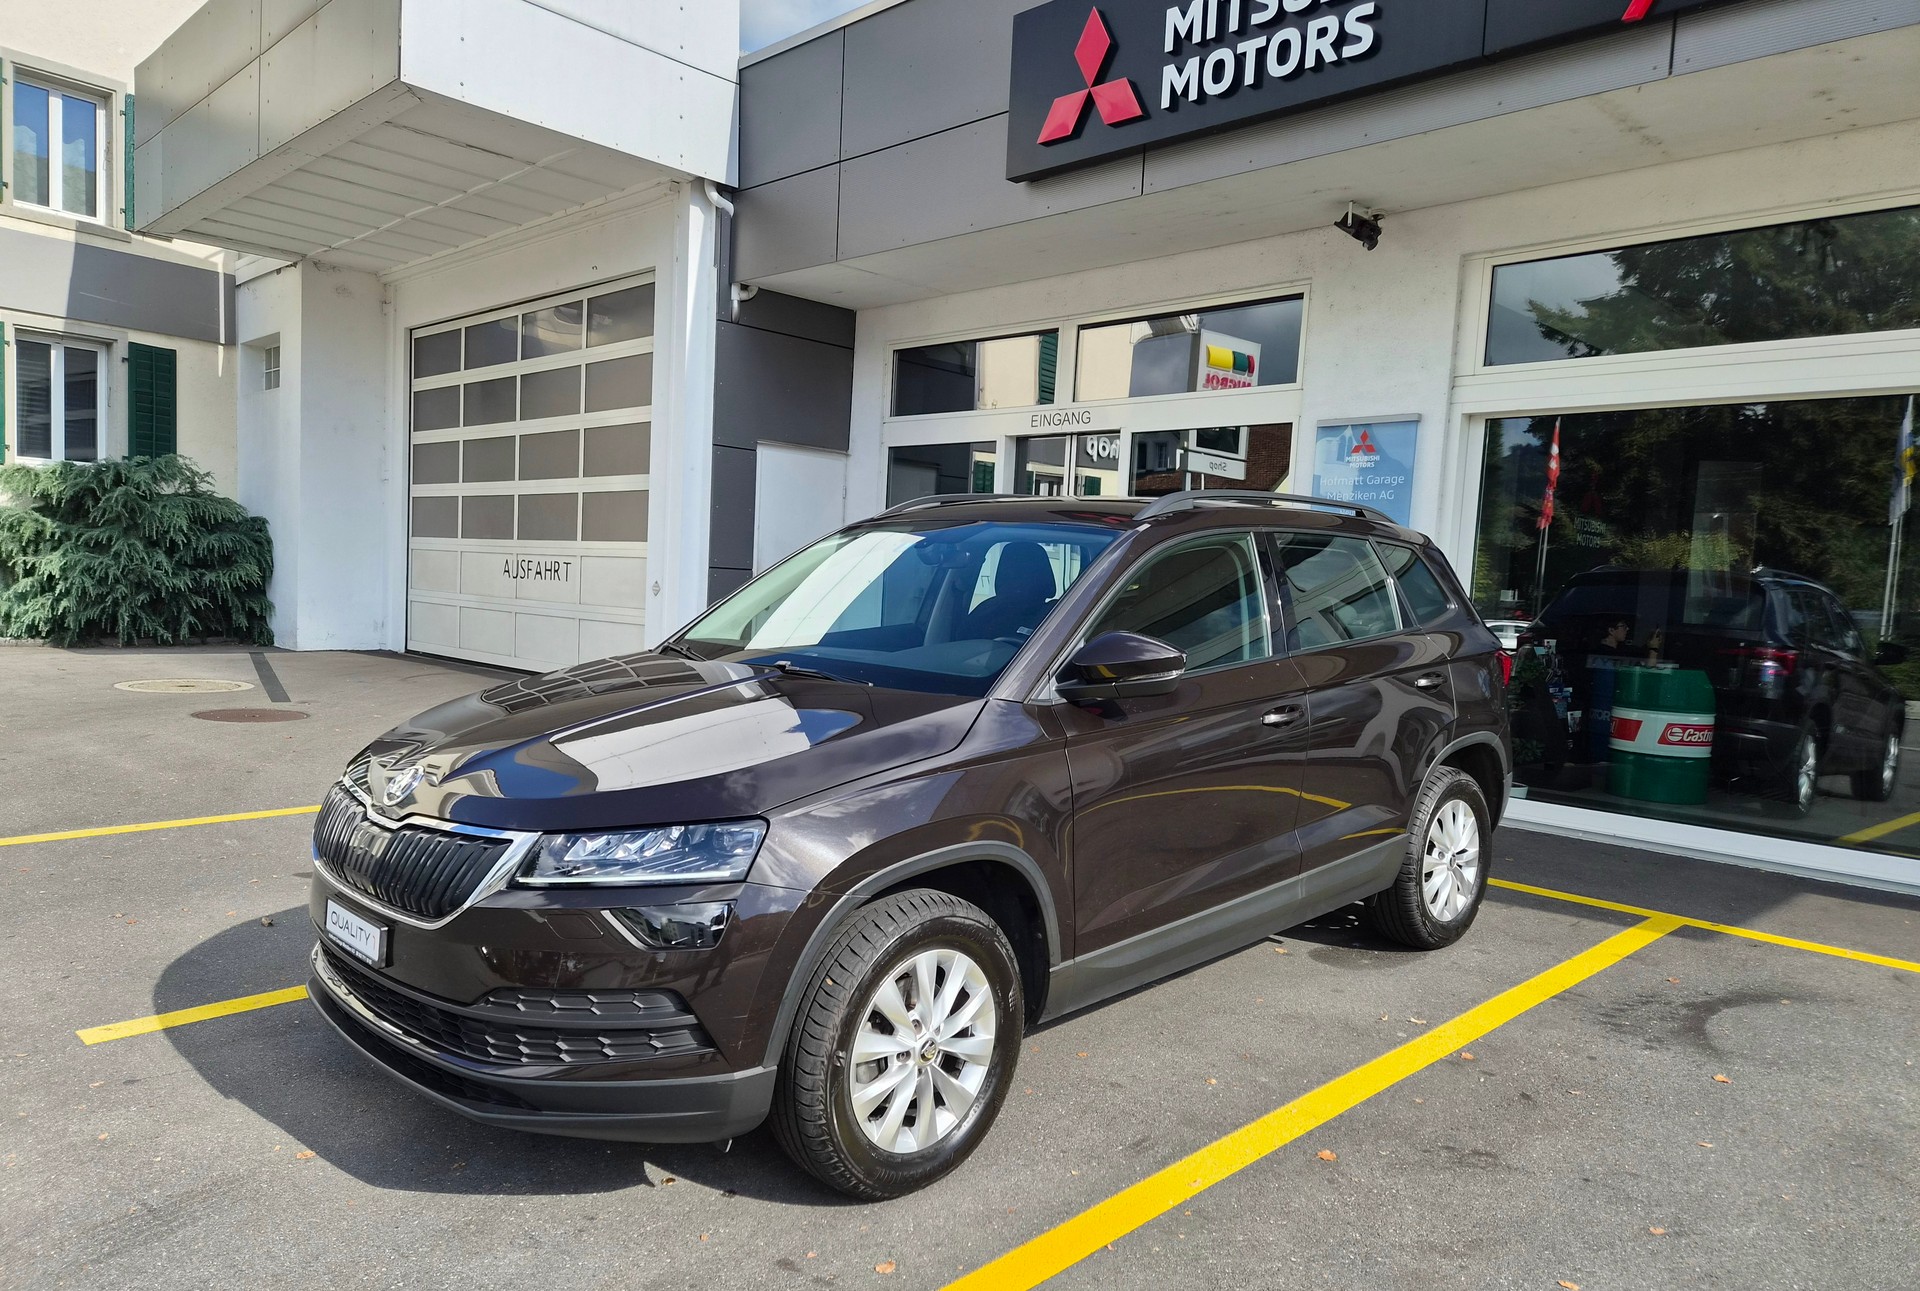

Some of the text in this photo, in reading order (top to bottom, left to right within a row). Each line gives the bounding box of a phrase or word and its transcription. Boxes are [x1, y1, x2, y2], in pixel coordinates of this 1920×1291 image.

[1164, 0, 1329, 53] MITS
[1160, 2, 1375, 110] MOTORS
[1031, 410, 1091, 428] EINGANG
[1345, 455, 1380, 463] MITSUBISHI
[1320, 474, 1405, 487] Hofmatt Garage
[1327, 489, 1395, 501] Menziken AG
[1573, 516, 1607, 534] MITSUBISHI
[1577, 533, 1600, 548] MOTORS
[503, 559, 572, 582] AUSFAHRT
[331, 910, 371, 946] QUALITY
